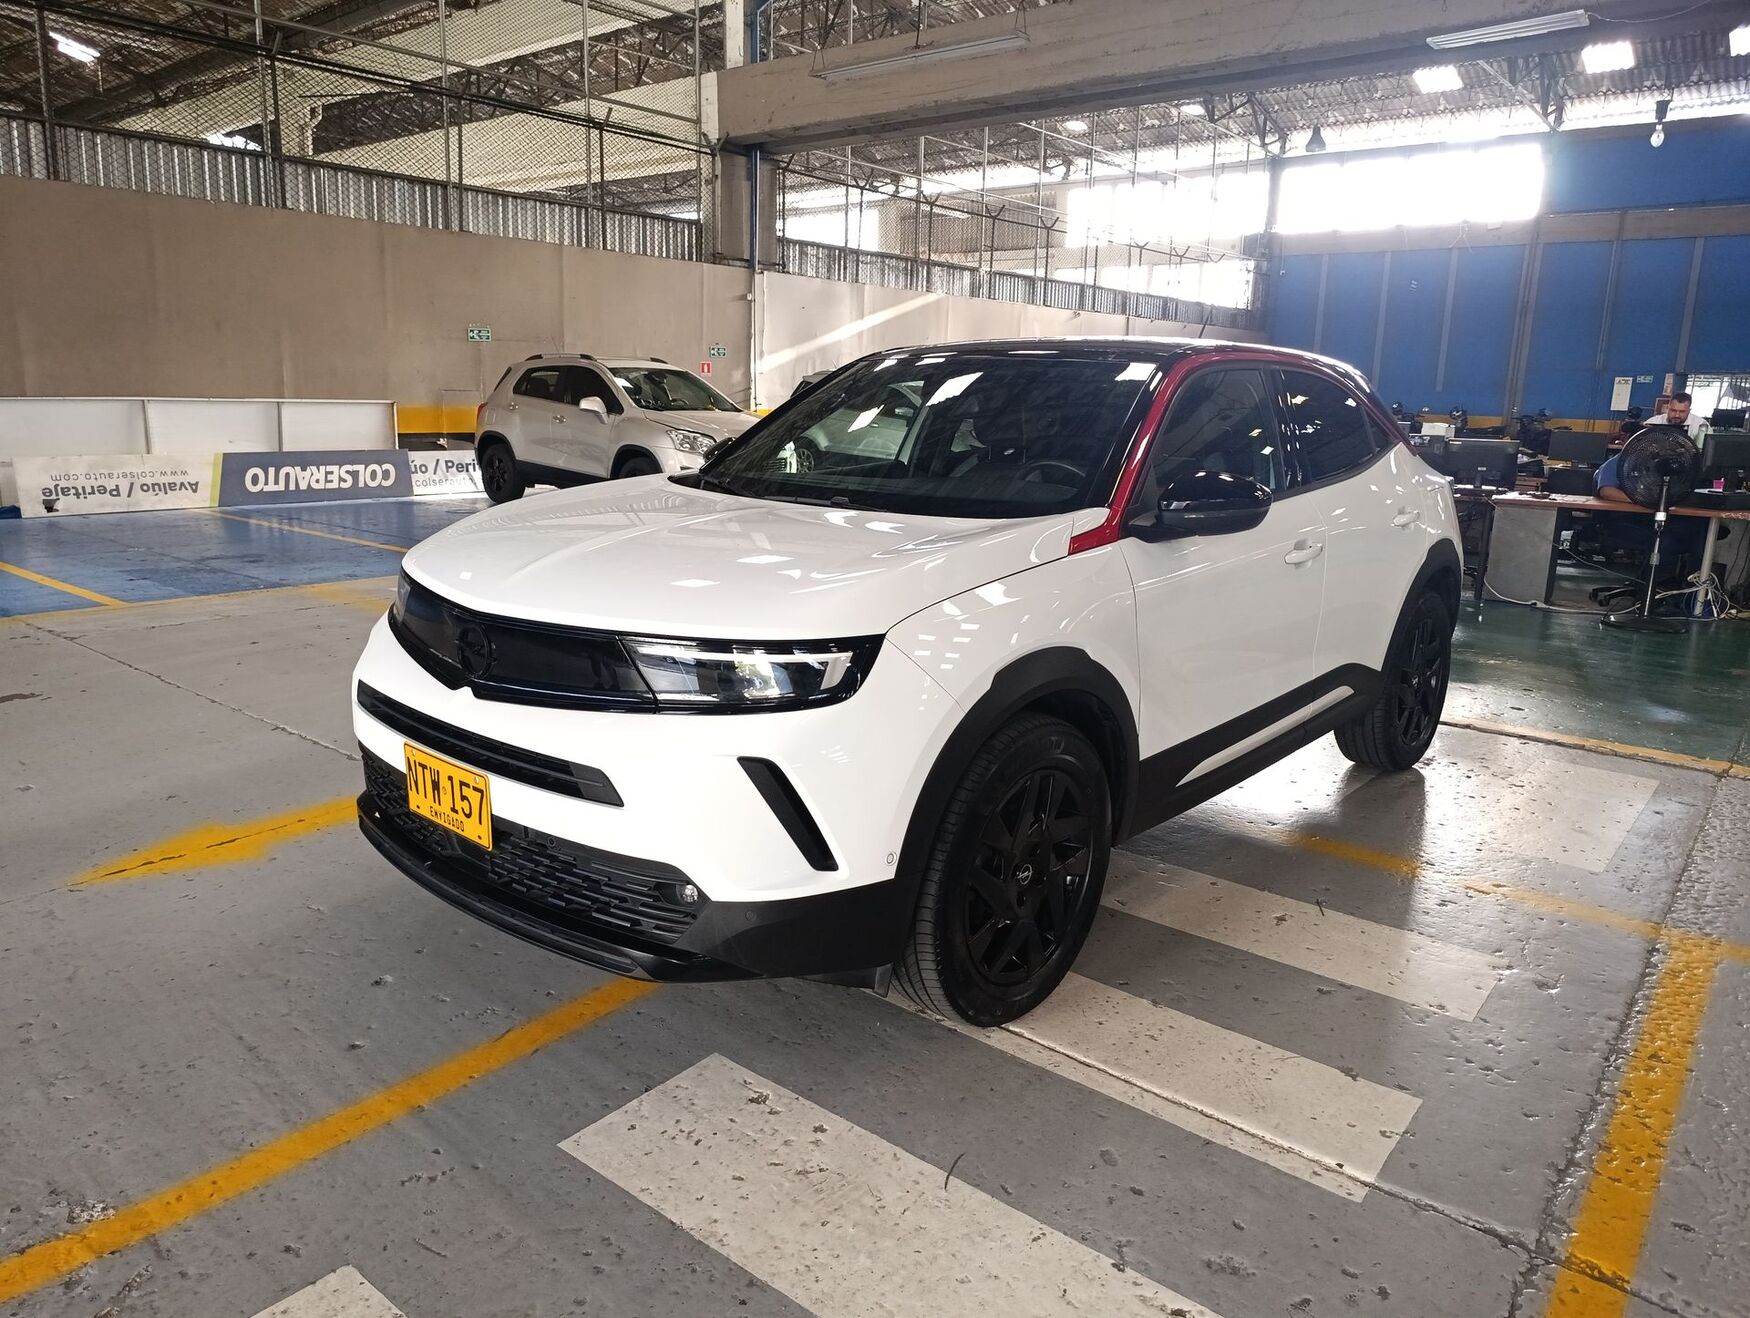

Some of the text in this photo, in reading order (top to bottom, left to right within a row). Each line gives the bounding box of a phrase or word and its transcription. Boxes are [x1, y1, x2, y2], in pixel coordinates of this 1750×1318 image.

[50, 470, 189, 482] www.colserauto.com
[445, 458, 480, 473] Peri
[244, 463, 396, 493] COLSERAUTO
[41, 481, 200, 500] Avalúo / Peritaje
[447, 775, 485, 826] 157
[429, 805, 465, 832] ENVIGADO
